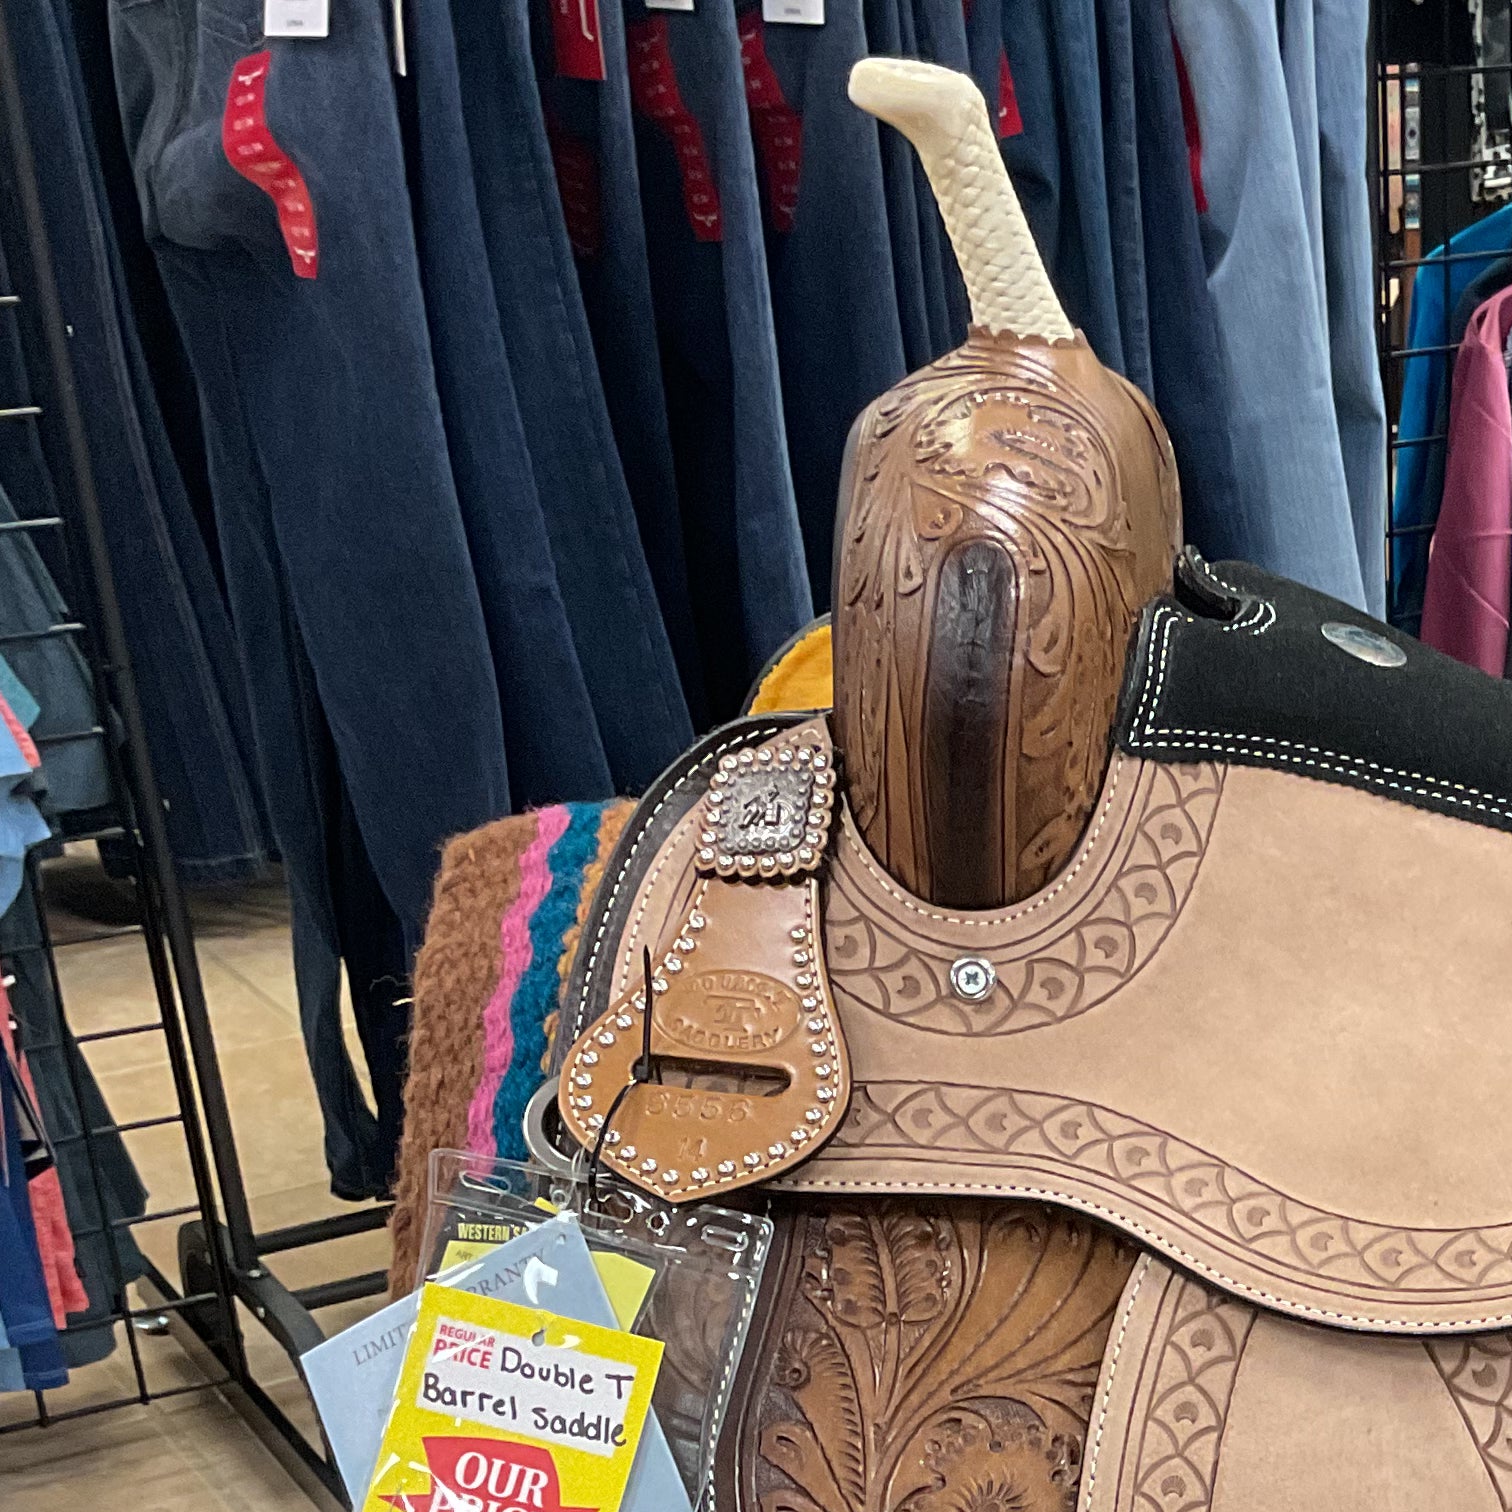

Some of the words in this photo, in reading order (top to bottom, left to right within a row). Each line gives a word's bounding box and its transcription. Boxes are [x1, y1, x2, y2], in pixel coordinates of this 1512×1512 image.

[457, 1222, 511, 1241] WESTERN
[352, 1321, 412, 1366] LIMIT
[422, 1372, 518, 1421] Barrel
[500, 1346, 594, 1395] Double
[604, 1373, 635, 1400] T
[454, 1451, 549, 1508] OUR
